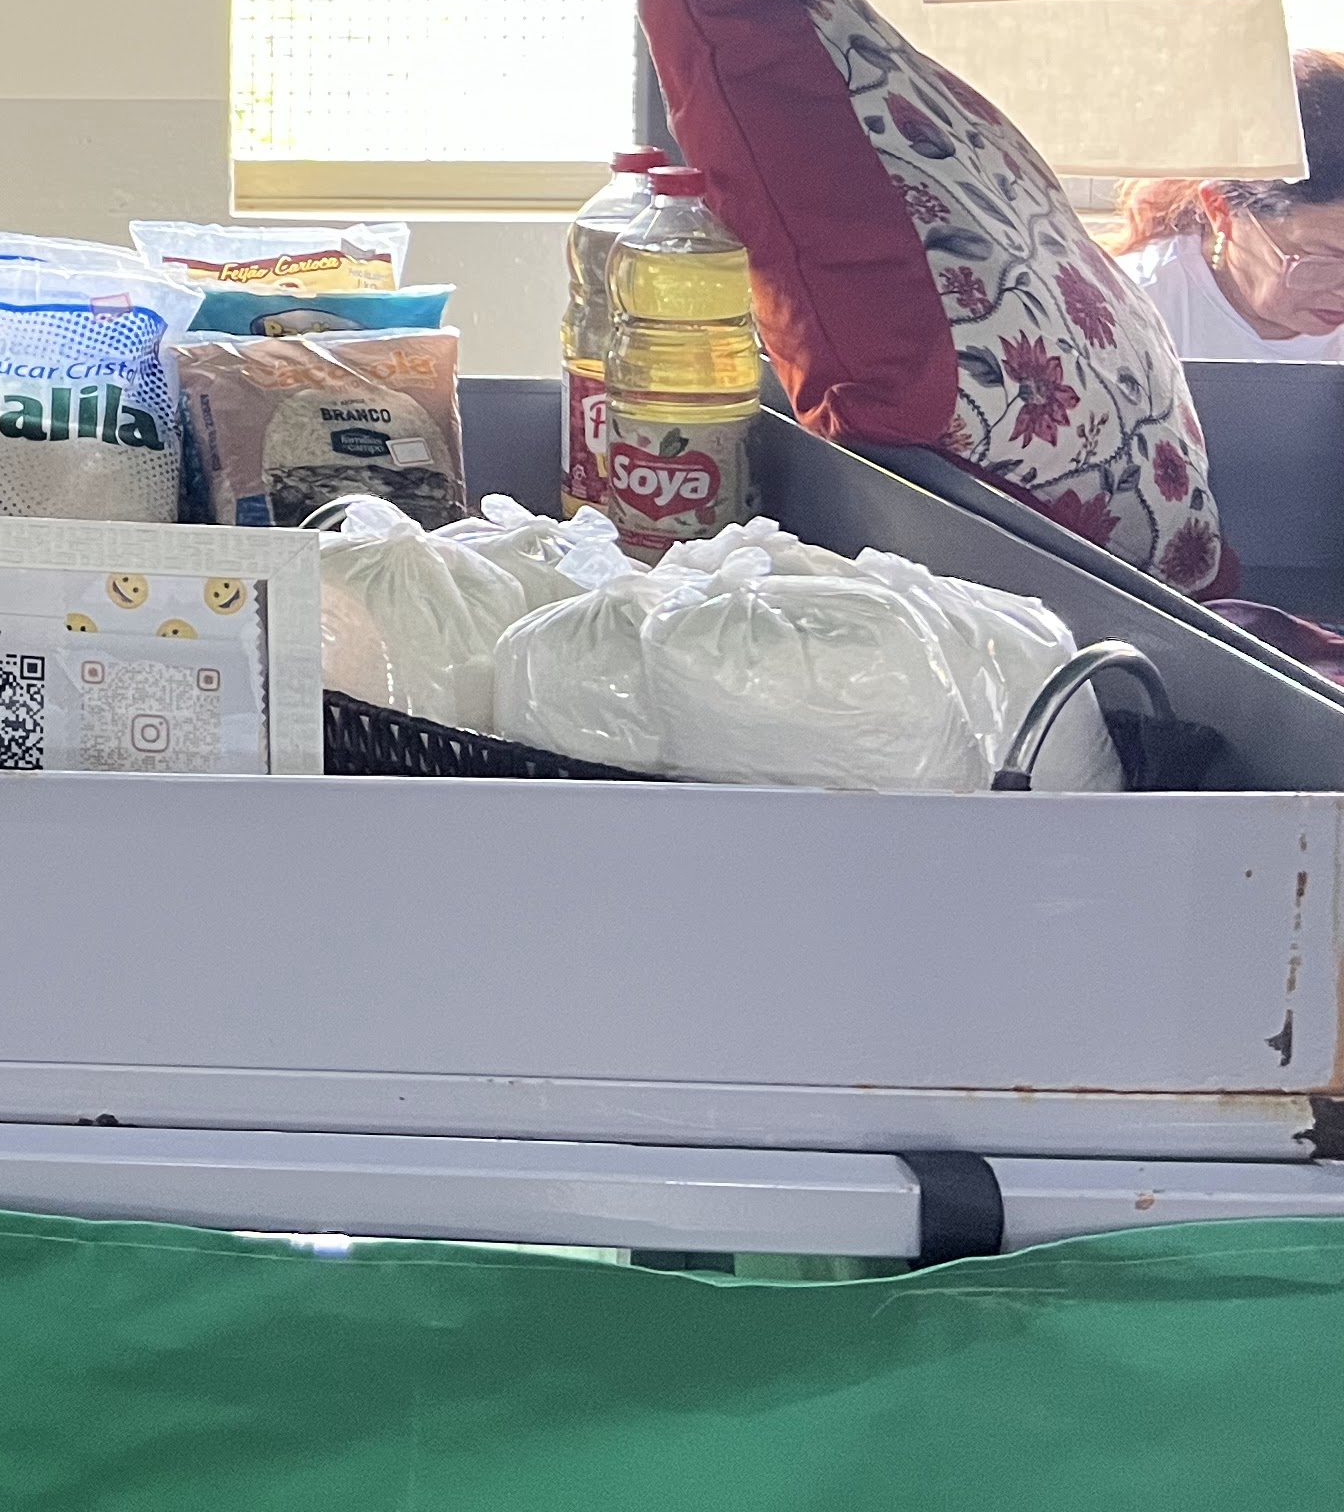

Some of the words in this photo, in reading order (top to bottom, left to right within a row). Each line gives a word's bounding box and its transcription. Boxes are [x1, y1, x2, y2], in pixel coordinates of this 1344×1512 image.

[220, 263, 270, 283] Feijão
[273, 254, 342, 276] Carioca
[320, 407, 391, 423] BRANCO
[613, 454, 710, 506] Soya
